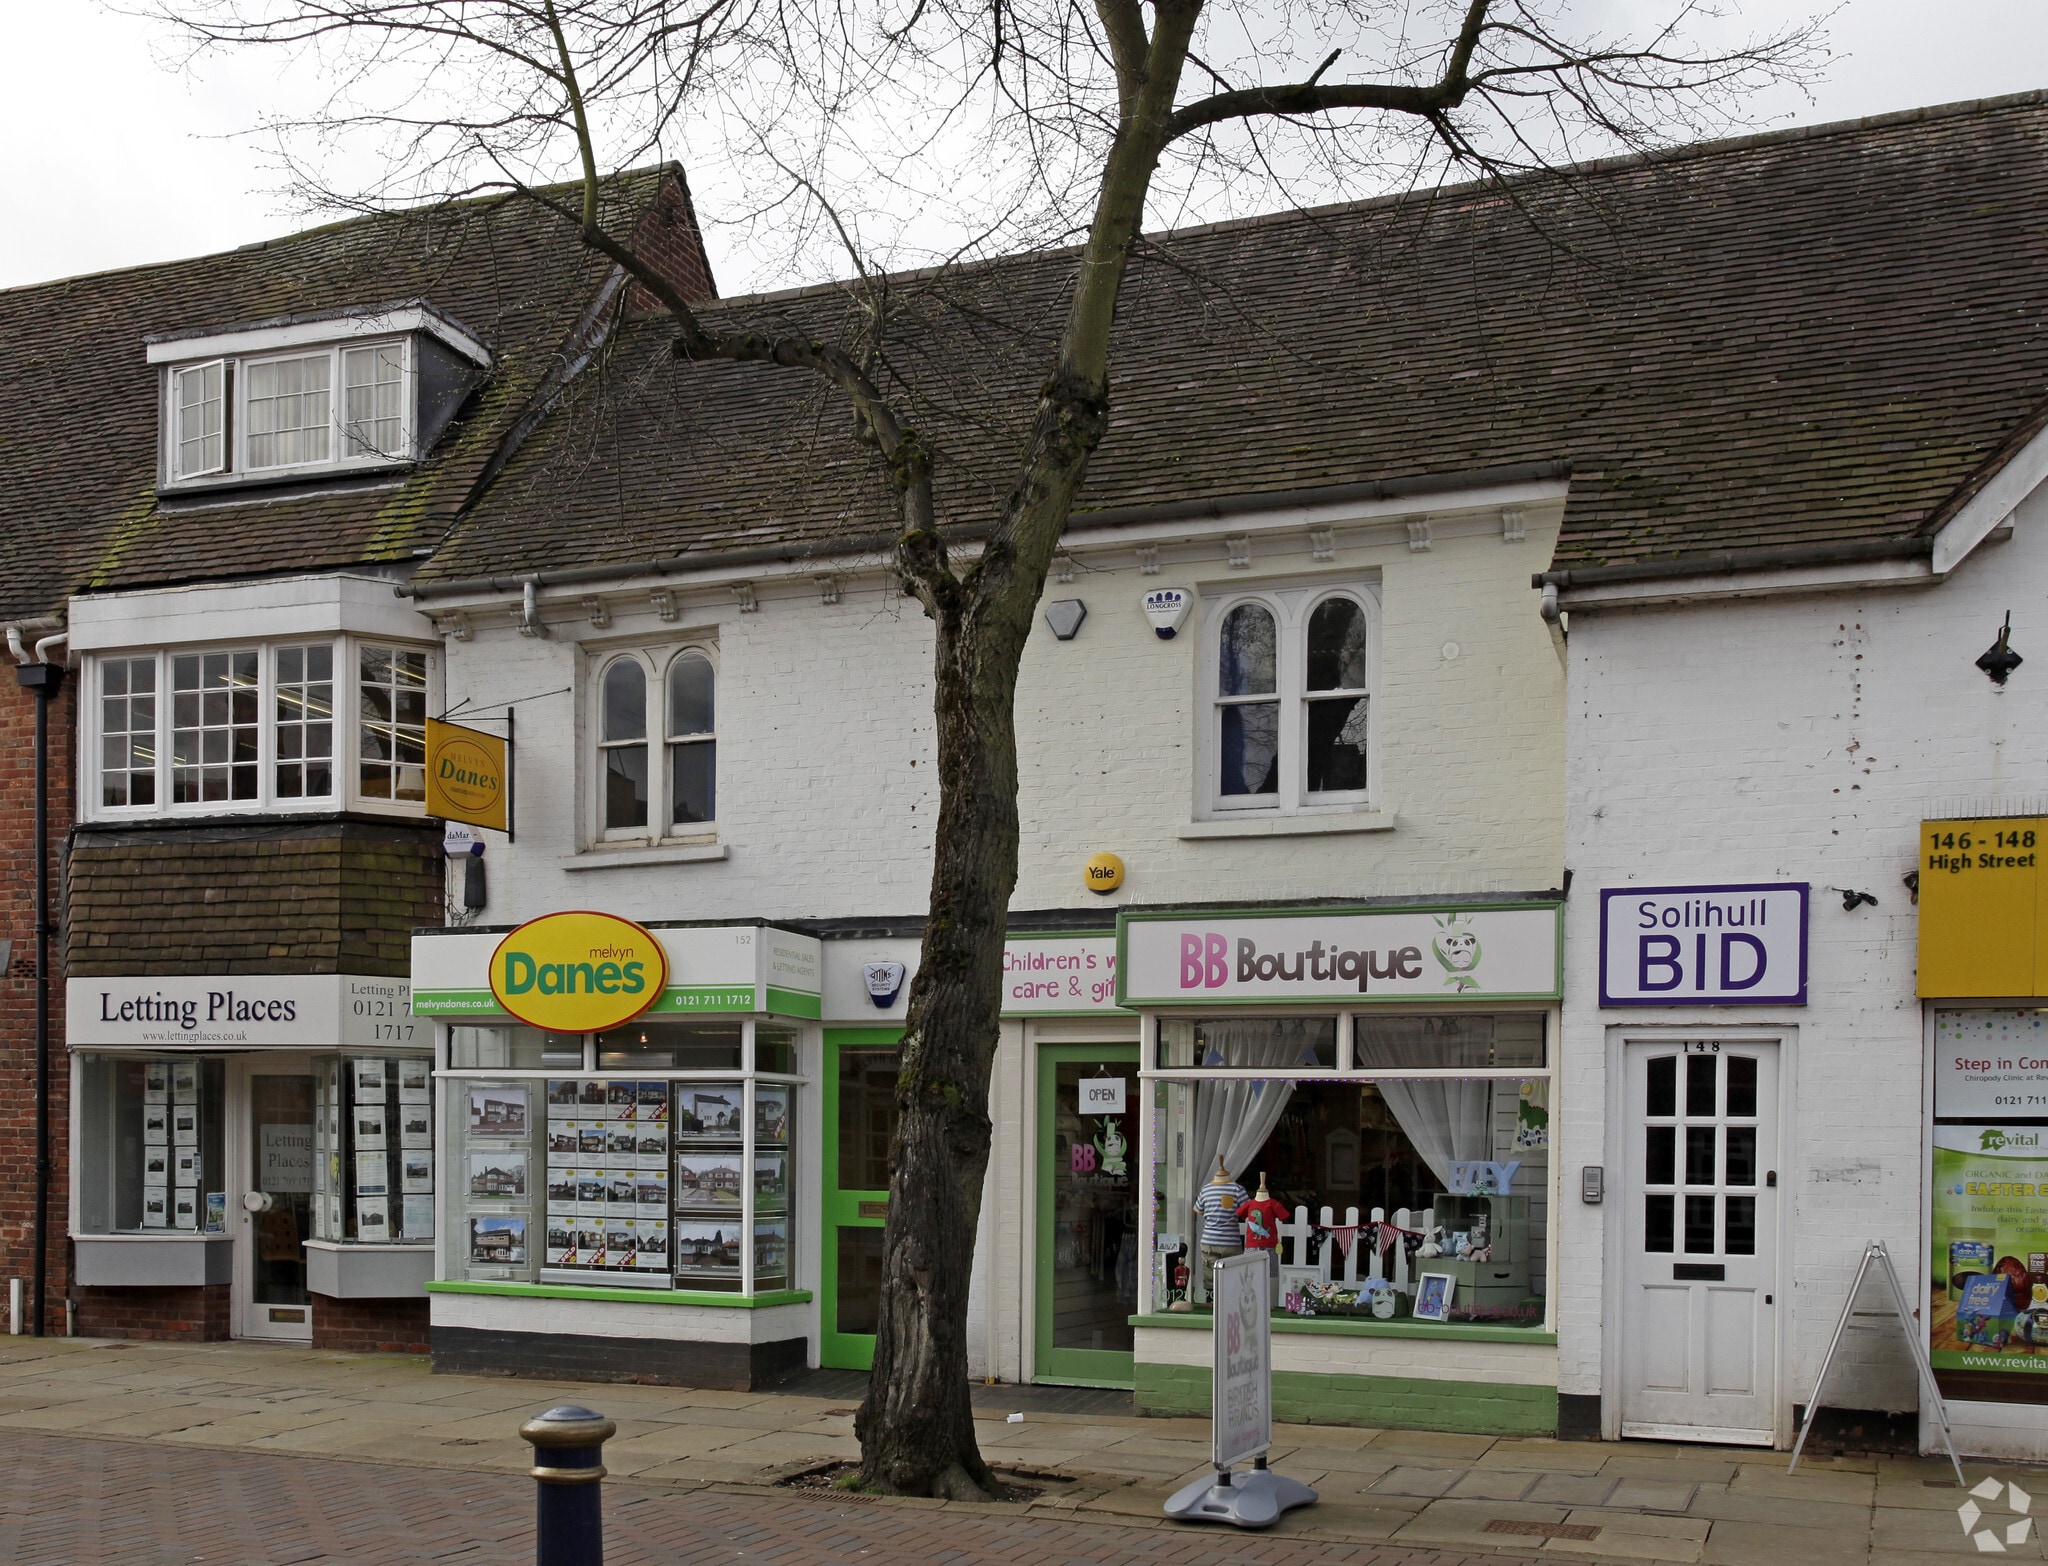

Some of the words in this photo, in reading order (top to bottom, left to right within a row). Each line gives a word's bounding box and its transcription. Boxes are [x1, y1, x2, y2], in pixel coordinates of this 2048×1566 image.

[450, 752, 485, 768] MELVYN
[439, 758, 498, 791] Danes
[447, 831, 470, 840] daMar
[1930, 831, 1972, 850] 146
[1994, 830, 2036, 848] 148
[1929, 852, 1972, 874] High
[1978, 851, 2036, 869] Street
[1089, 866, 1115, 879] Yale
[1638, 899, 1767, 929] Solihull
[735, 935, 751, 945] 152
[589, 943, 634, 962] melvyn
[773, 947, 801, 960] RESIDENTIAL
[801, 952, 815, 963] SALES
[1002, 948, 1097, 971] Children's
[777, 962, 796, 973] LETTING
[797, 966, 815, 977] AGENTS
[1180, 932, 1228, 989] BB
[1236, 939, 1423, 993] Boutique
[1638, 933, 1768, 992] BID
[505, 952, 645, 995] Danes
[351, 983, 394, 998] Letting
[1012, 981, 1059, 999] care
[1068, 975, 1082, 996] &
[416, 998, 495, 1010] melvyndanes.co.uk
[675, 996, 699, 1006] 0121
[704, 995, 721, 1005] 711
[726, 994, 751, 1005] 1712
[100, 991, 198, 1031] Letting
[206, 990, 297, 1022] Places
[353, 1000, 394, 1017] 0121
[142, 1031, 248, 1043] www.lettingplaces.co.uk
[375, 1024, 414, 1041] 1717
[1683, 1041, 1720, 1053] 148
[1955, 1057, 1991, 1073] Step
[1997, 1057, 2012, 1069] in
[1964, 1074, 2001, 1082] Chiropody
[1089, 1088, 1116, 1102] OPEN
[1995, 1095, 2022, 1105] 0121
[2027, 1095, 2047, 1105] 711
[621, 1102, 637, 1118] SOLD
[651, 1102, 667, 1119] SOLD
[266, 1132, 312, 1151] Letting
[1989, 1133, 2039, 1146] revital
[268, 1153, 310, 1168] Places
[1071, 1143, 1096, 1172] BB
[262, 1176, 279, 1186] 0121
[298, 1176, 313, 1187] 171
[1965, 1170, 2012, 1179] ORGANIC
[2015, 1171, 2032, 1179] and
[1966, 1182, 2035, 1197] EASTER
[1971, 1205, 2004, 1214] Indulge
[2006, 1205, 2022, 1213] this
[1997, 1215, 2019, 1224] dairy
[2022, 1215, 2039, 1223] and
[560, 1246, 576, 1262] SOLD
[590, 1247, 605, 1263] SOLD
[620, 1249, 636, 1265] SOLD
[1972, 1283, 2000, 1297] dairy
[1285, 1292, 1303, 1312] BB
[1967, 1294, 1990, 1306] free
[1417, 1301, 1537, 1319] bb-boutique.co.uk
[1227, 1311, 1241, 1357] BB
[1962, 1355, 2048, 1369] www.revita
